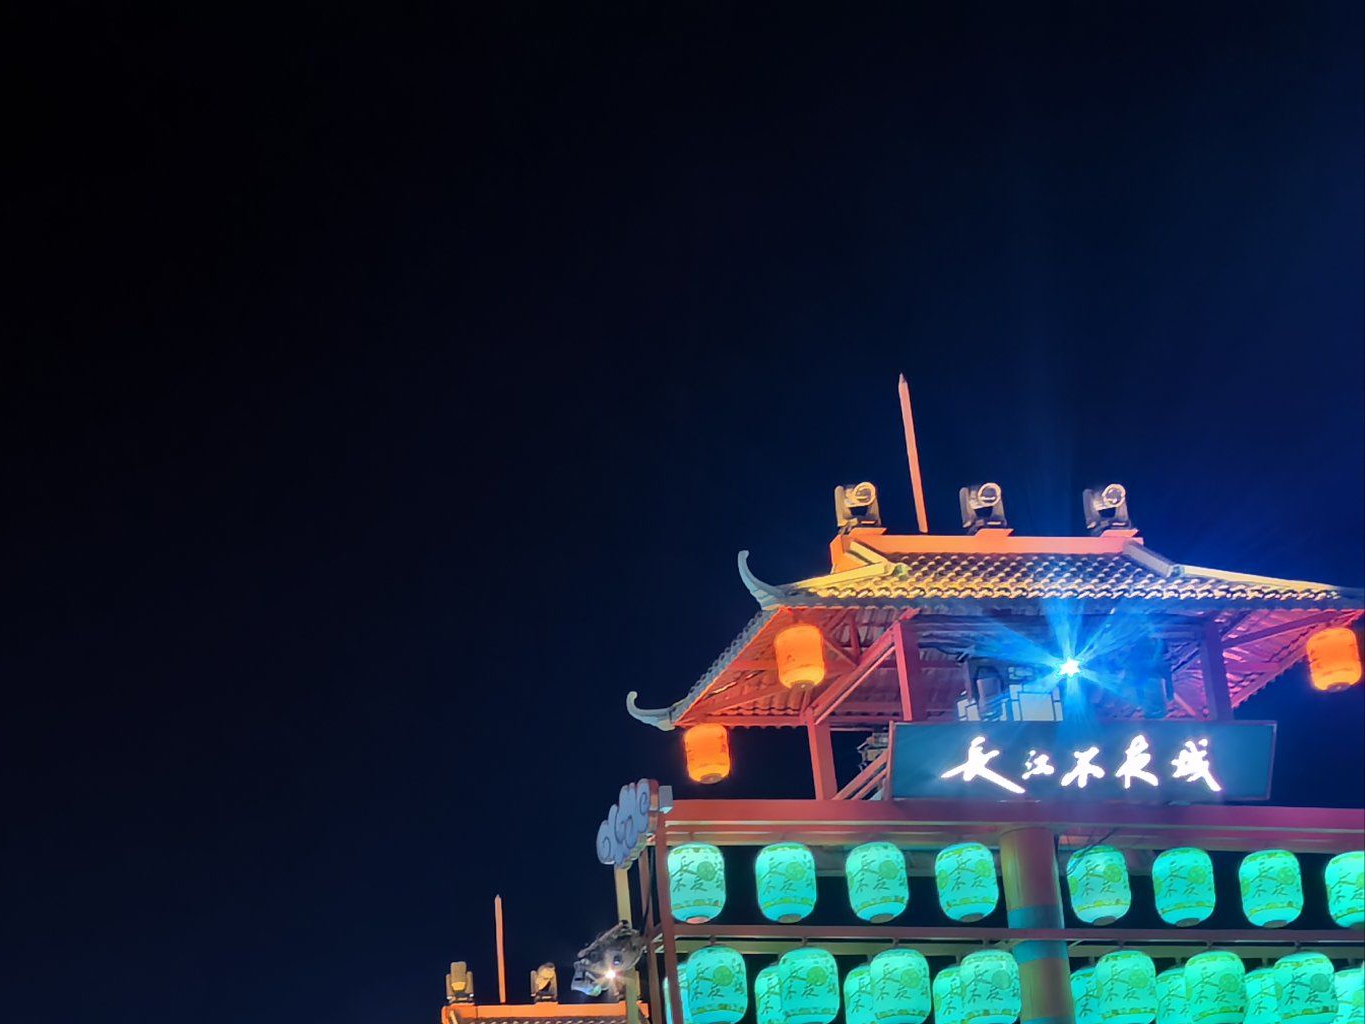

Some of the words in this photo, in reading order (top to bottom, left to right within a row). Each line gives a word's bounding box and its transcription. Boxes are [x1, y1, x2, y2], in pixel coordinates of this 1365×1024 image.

[940, 735, 1222, 794] 长江不夜城
